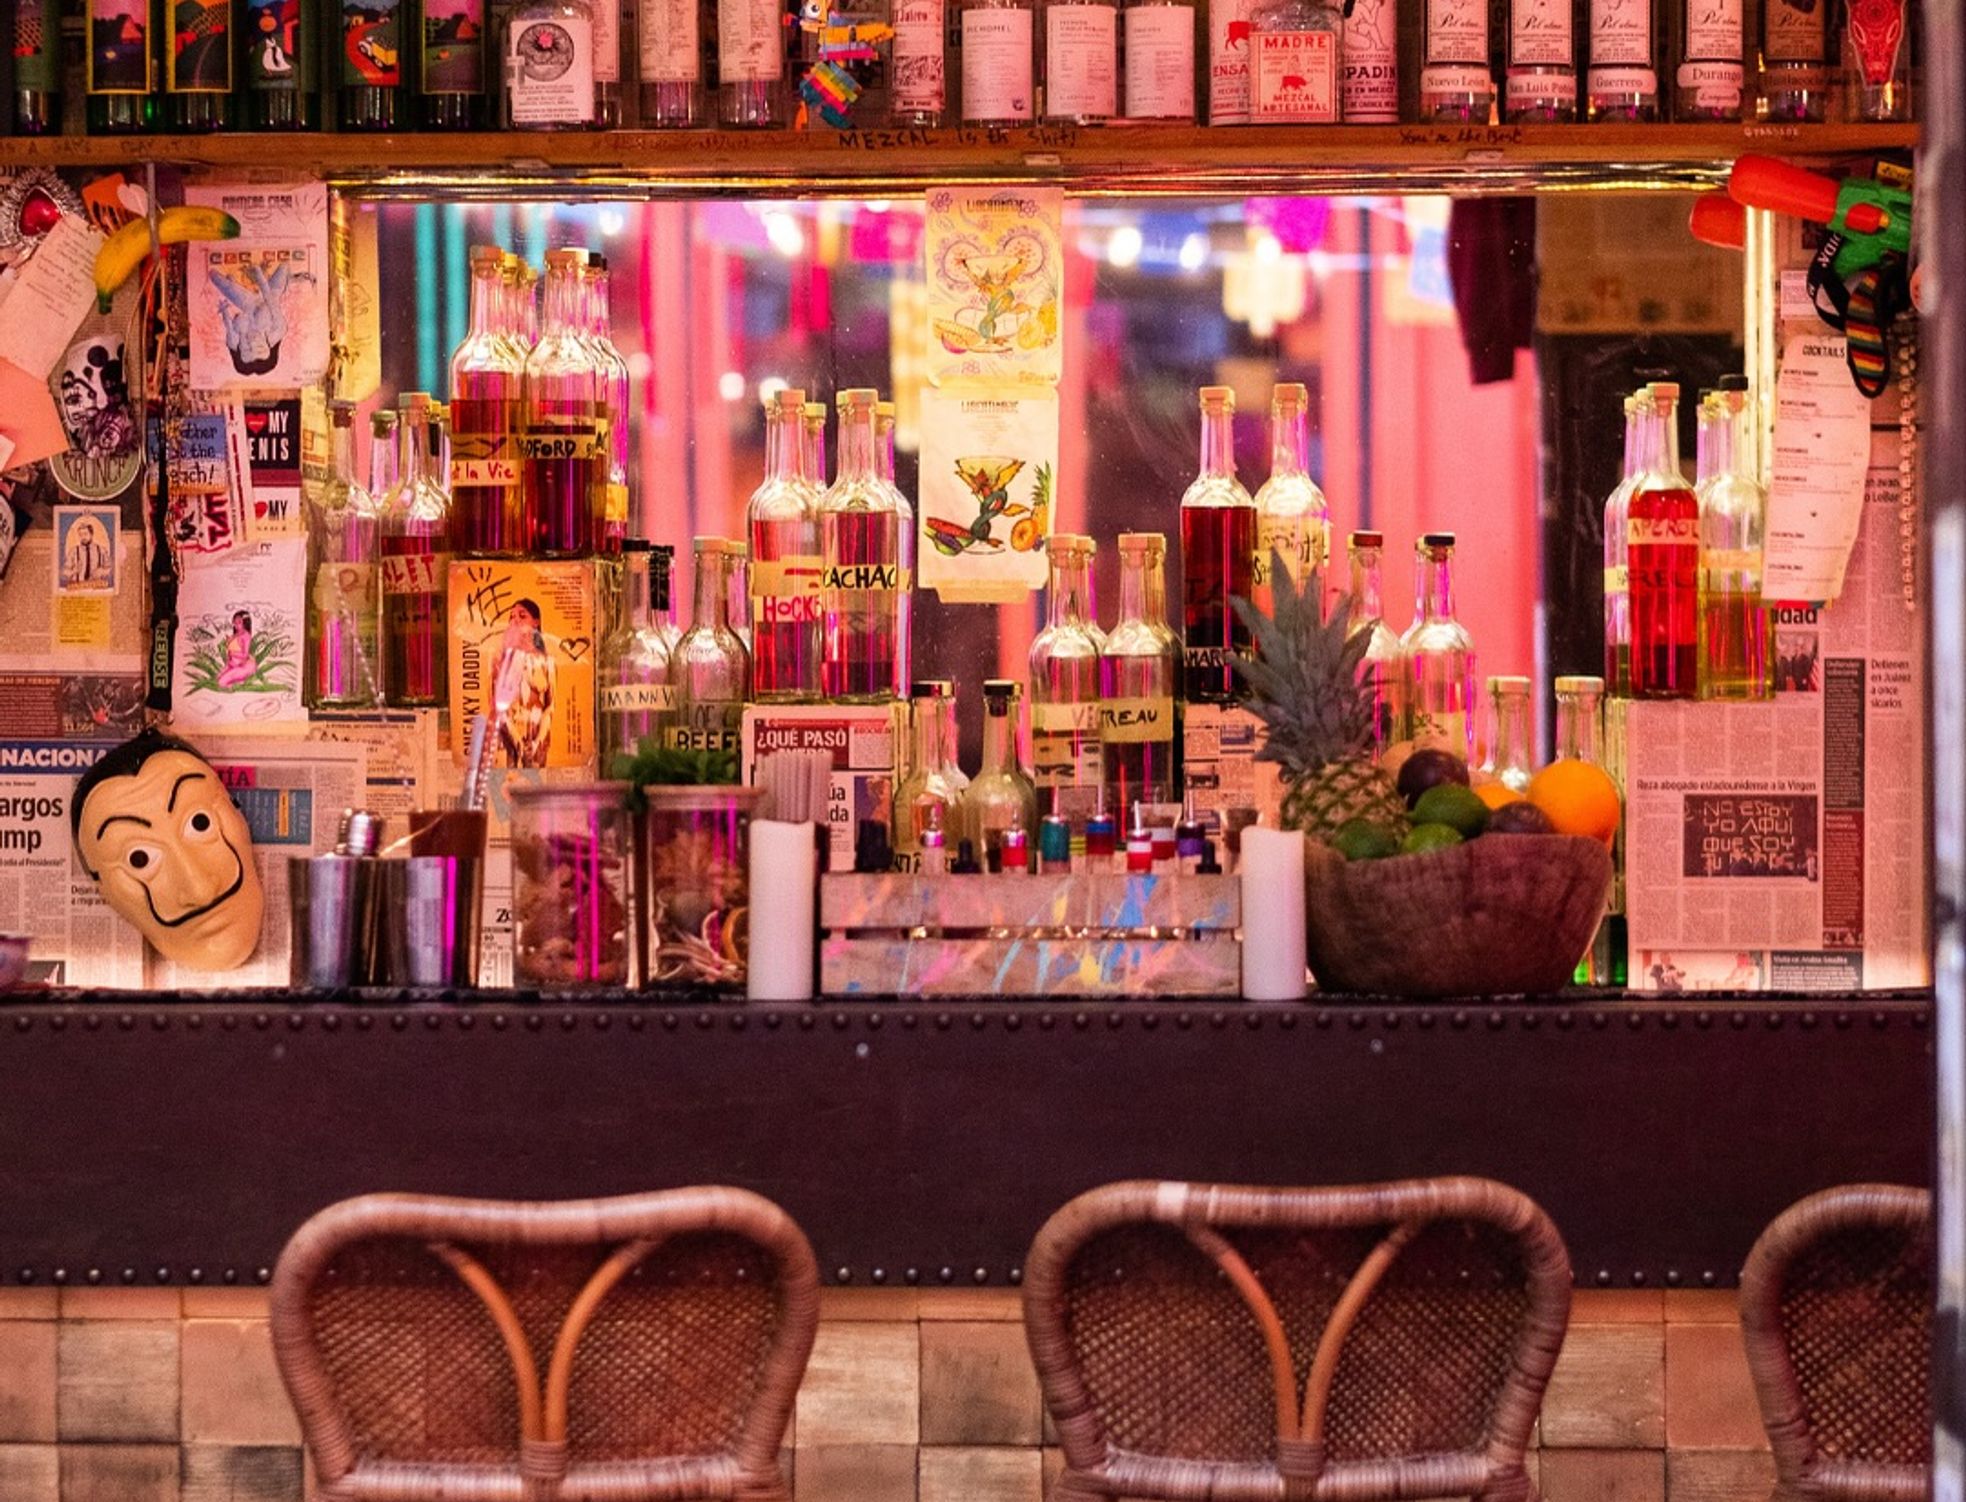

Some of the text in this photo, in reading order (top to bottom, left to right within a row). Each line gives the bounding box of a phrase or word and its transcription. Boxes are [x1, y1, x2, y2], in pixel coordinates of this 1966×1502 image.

[1264, 36, 1327, 49] MADRE
[1527, 82, 1549, 93] Luis
[1595, 76, 1643, 88] Guerrero
[1273, 93, 1316, 102] MEZCAL
[1263, 103, 1328, 112] ARTESANAL
[839, 132, 938, 149] MEZCAL
[1487, 128, 1522, 144] Best
[1802, 344, 1846, 358] COCKTAILS
[268, 411, 290, 434] MY
[488, 462, 515, 480] Vie
[268, 500, 288, 521] MY
[153, 626, 169, 688] REUSE
[462, 640, 480, 690] DADDY
[757, 728, 847, 748] ¿QUÉ PASÓ
[1660, 779, 1699, 791] abogado
[1787, 779, 1817, 791] Virgen
[0, 797, 63, 821] argos
[1703, 801, 1734, 816] NO
[1703, 818, 1736, 834] YO
[0, 829, 42, 854] mp
[1750, 836, 1795, 852] SOY
